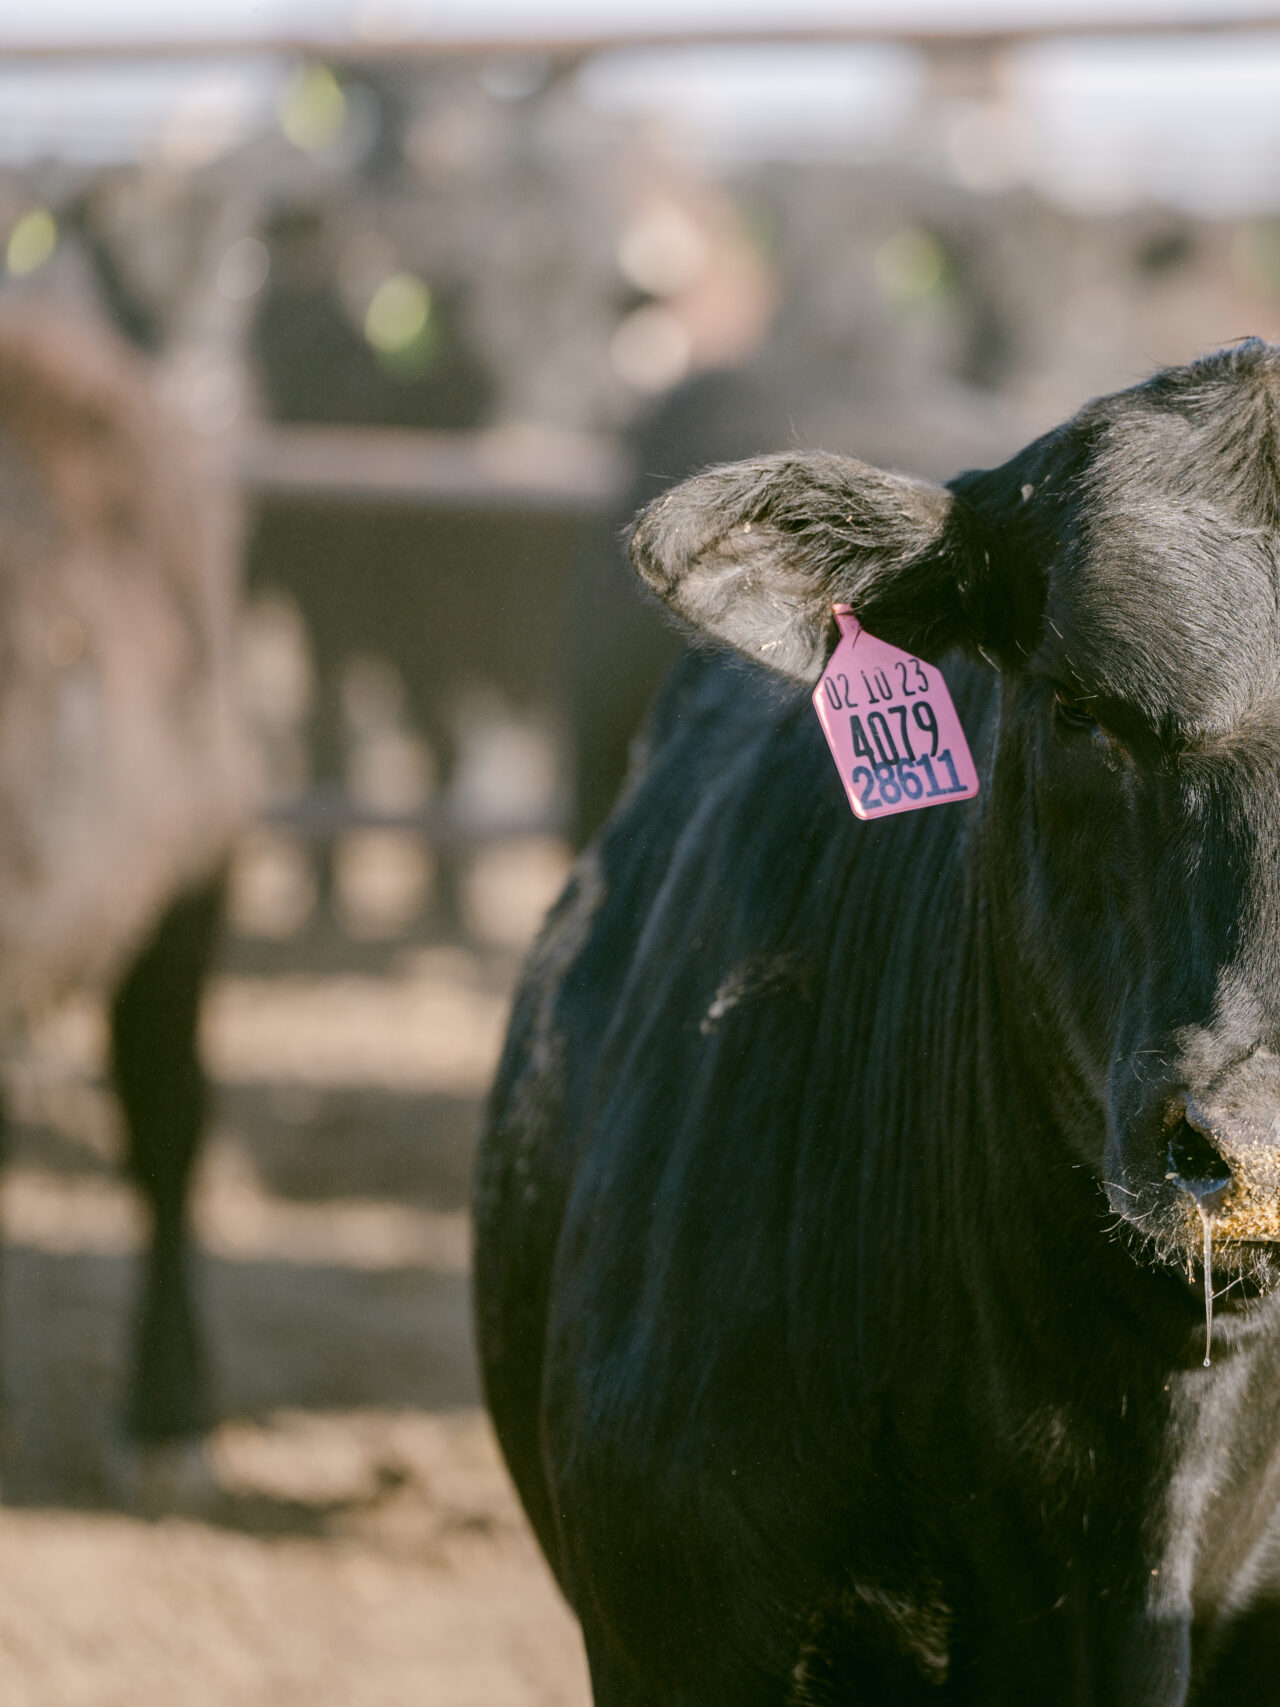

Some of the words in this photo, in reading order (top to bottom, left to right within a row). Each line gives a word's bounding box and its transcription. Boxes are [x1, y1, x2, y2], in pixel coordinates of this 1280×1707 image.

[824, 673, 858, 710] 02
[860, 666, 893, 704] 10
[895, 658, 929, 697] 23
[849, 701, 939, 770] 4079
[852, 748, 968, 810] 28611
